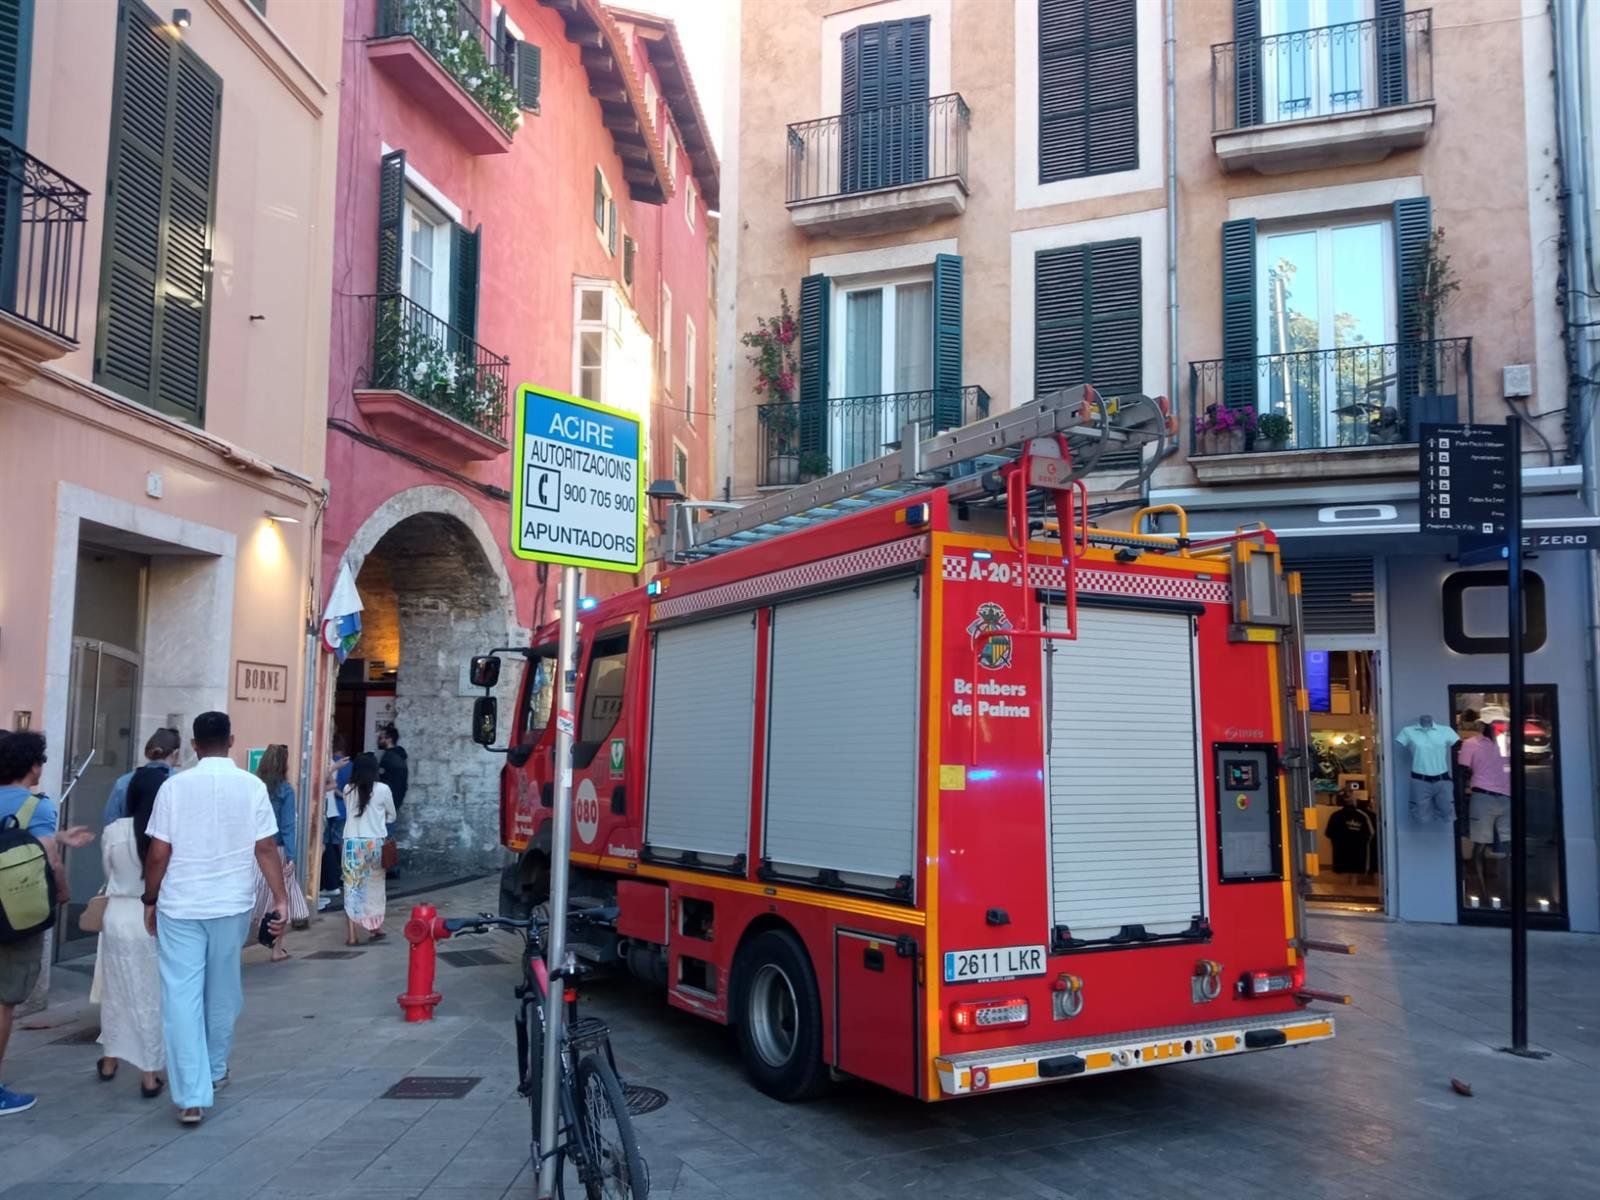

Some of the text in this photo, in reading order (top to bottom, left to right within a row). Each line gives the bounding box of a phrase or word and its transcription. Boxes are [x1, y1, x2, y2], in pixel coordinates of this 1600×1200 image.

[549, 413, 614, 448] ACIRE
[531, 440, 631, 482] AUTORITZACIONS
[564, 484, 635, 513] 900 705 900
[524, 521, 635, 553] APUNTADORS
[1540, 535, 1587, 545] ZERO
[244, 668, 279, 691] BORNE
[954, 678, 1026, 697] Bombers
[951, 699, 1030, 718] de Palma
[576, 798, 598, 825] 080
[958, 949, 1041, 976] 2611 LKR
